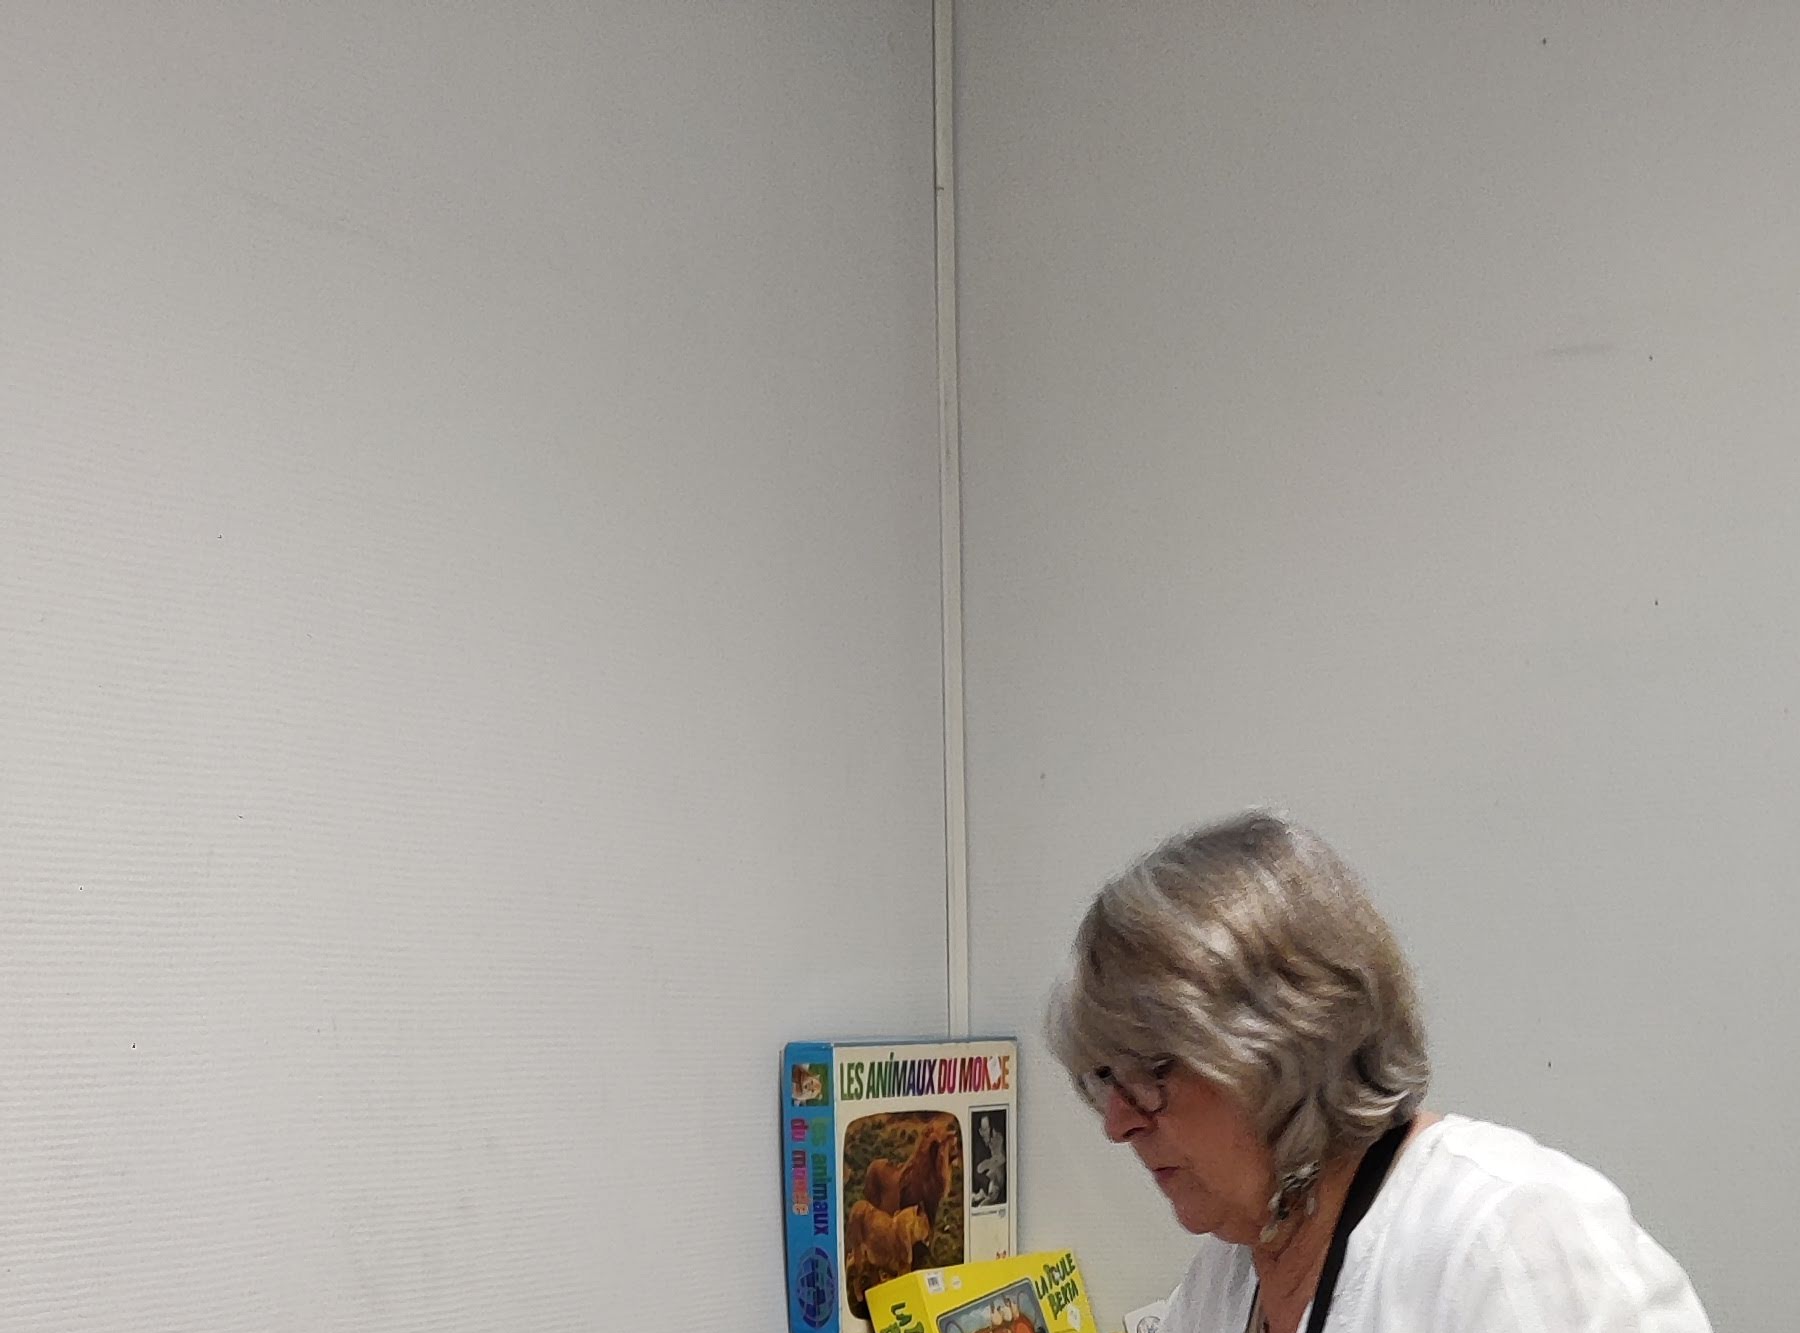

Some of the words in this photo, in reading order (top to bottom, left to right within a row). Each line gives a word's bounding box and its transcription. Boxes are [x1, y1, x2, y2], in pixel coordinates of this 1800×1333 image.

[840, 1062, 864, 1101] LES
[866, 1052, 938, 1099] ANIMAUX
[937, 1058, 956, 1095] DU
[810, 1153, 830, 1237] animaux
[1034, 1275, 1050, 1301] LA
[890, 1302, 913, 1327] LA
